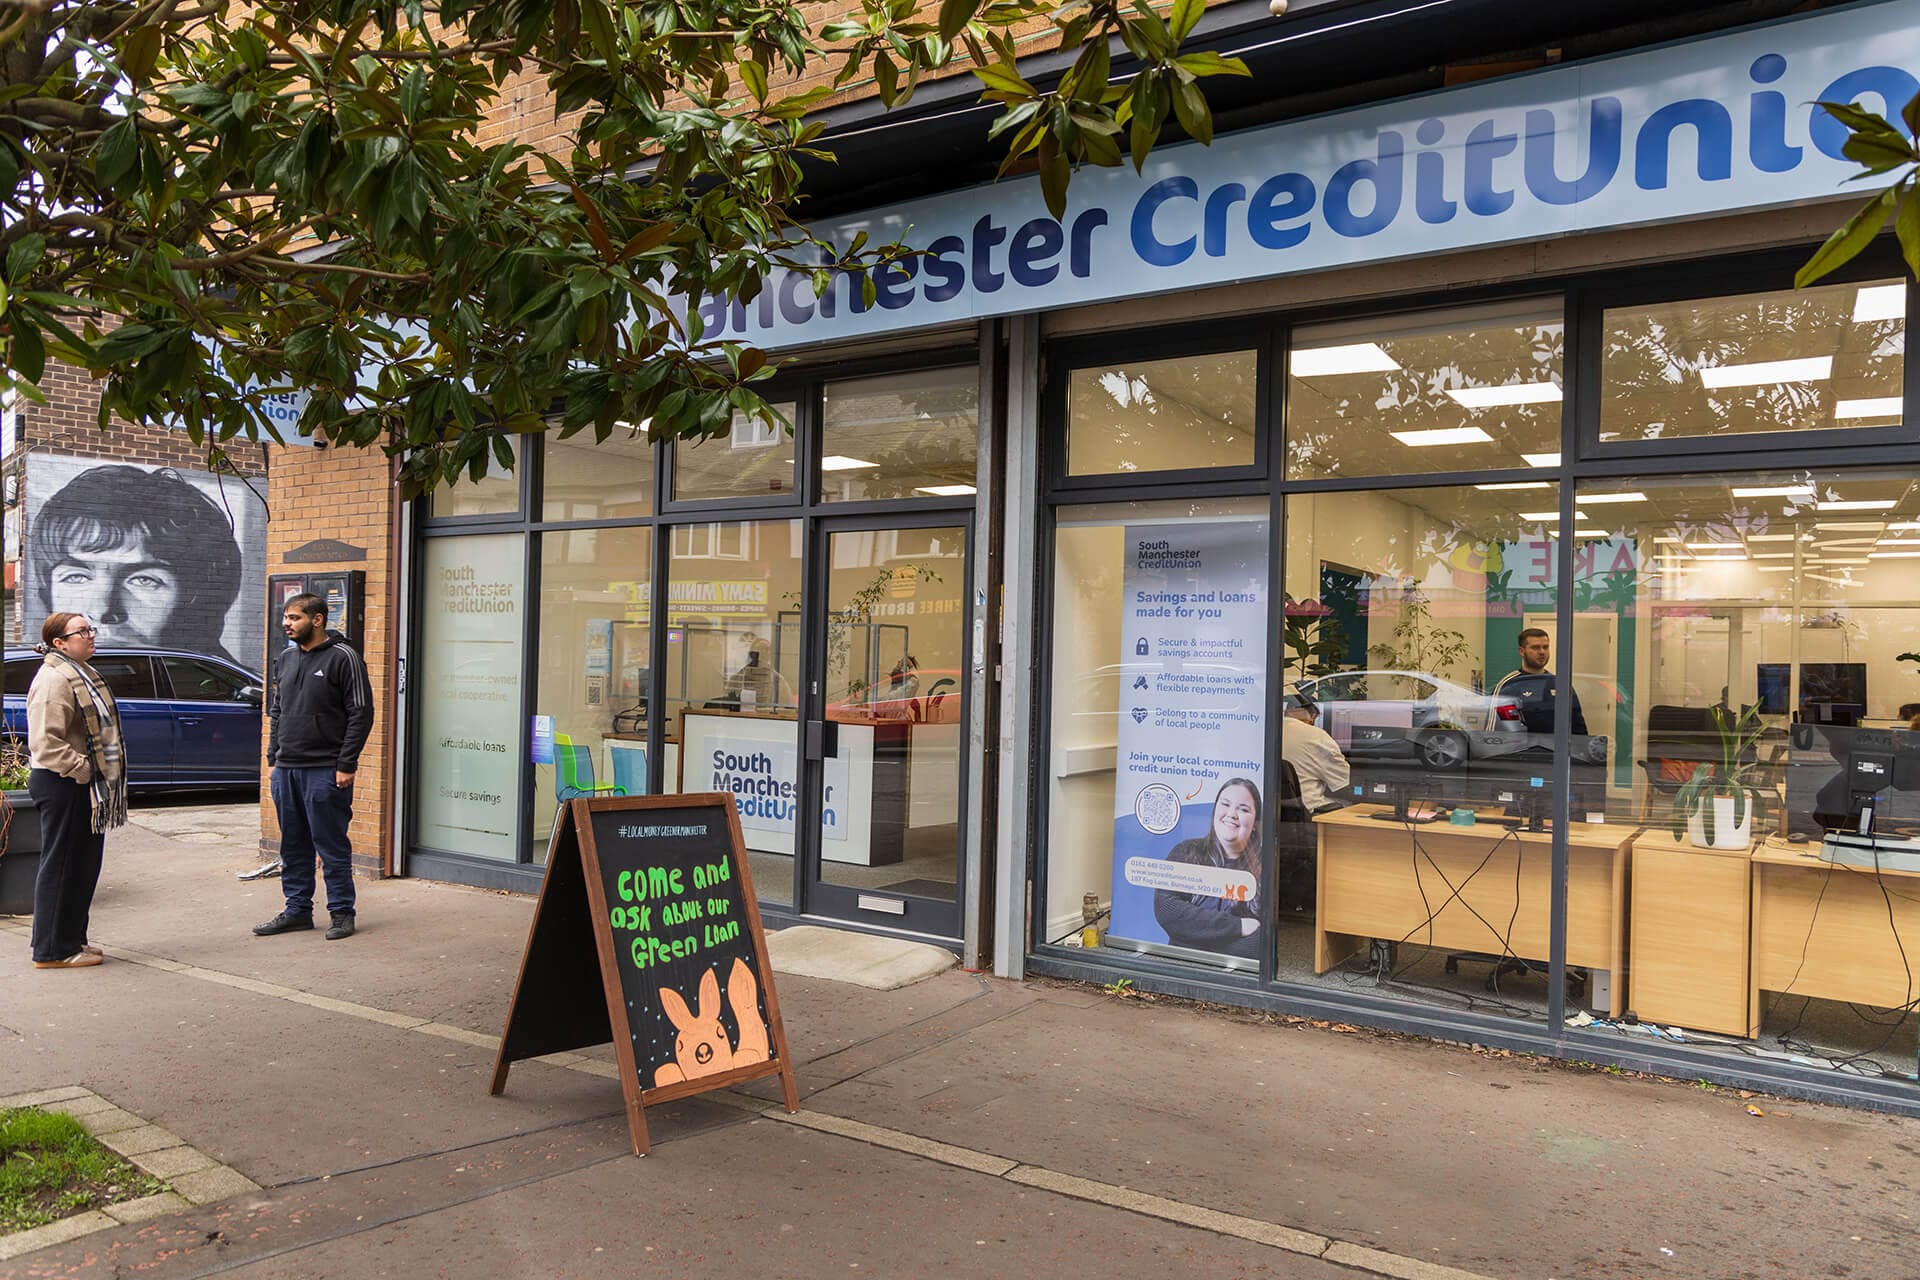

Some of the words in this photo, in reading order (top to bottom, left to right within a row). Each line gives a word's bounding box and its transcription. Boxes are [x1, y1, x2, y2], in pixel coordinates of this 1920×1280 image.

[1138, 540, 1170, 551] South
[1138, 550, 1201, 560] Manchester
[1137, 559, 1202, 569] CreditUnion
[441, 596, 514, 613] reditUnion
[1136, 591, 1187, 605] Savings
[1191, 591, 1215, 603] and
[1219, 591, 1256, 603] loans
[1136, 606, 1171, 618] made
[1175, 606, 1194, 618] for
[1198, 608, 1222, 620] you
[1157, 638, 1189, 647] Secure
[1190, 638, 1198, 647] &
[1199, 638, 1243, 649] impactful
[1157, 648, 1191, 659] savings
[1193, 649, 1233, 658] accounts
[1156, 673, 1205, 683] Affordable
[1206, 675, 1232, 684] loans
[1233, 675, 1255, 685] with
[1156, 683, 1190, 693] flexible
[1191, 686, 1246, 696] repayments
[1155, 707, 1187, 719] Belong
[1189, 710, 1199, 719] to
[1208, 711, 1260, 724] community
[1154, 718, 1164, 727] of
[1166, 719, 1188, 728] local
[1189, 721, 1221, 731] people
[483, 740, 506, 753] loans
[713, 749, 772, 774] South
[1129, 751, 1149, 762] Join
[1151, 754, 1174, 765] your
[1176, 754, 1200, 766] local
[1203, 759, 1261, 772] community
[1128, 763, 1159, 774] credit
[1160, 765, 1188, 776] union
[1190, 767, 1220, 780] today
[469, 790, 502, 805] savings
[693, 854, 731, 890] and
[610, 905, 652, 932] ask
[707, 898, 730, 917] our
[631, 936, 698, 969] Green
